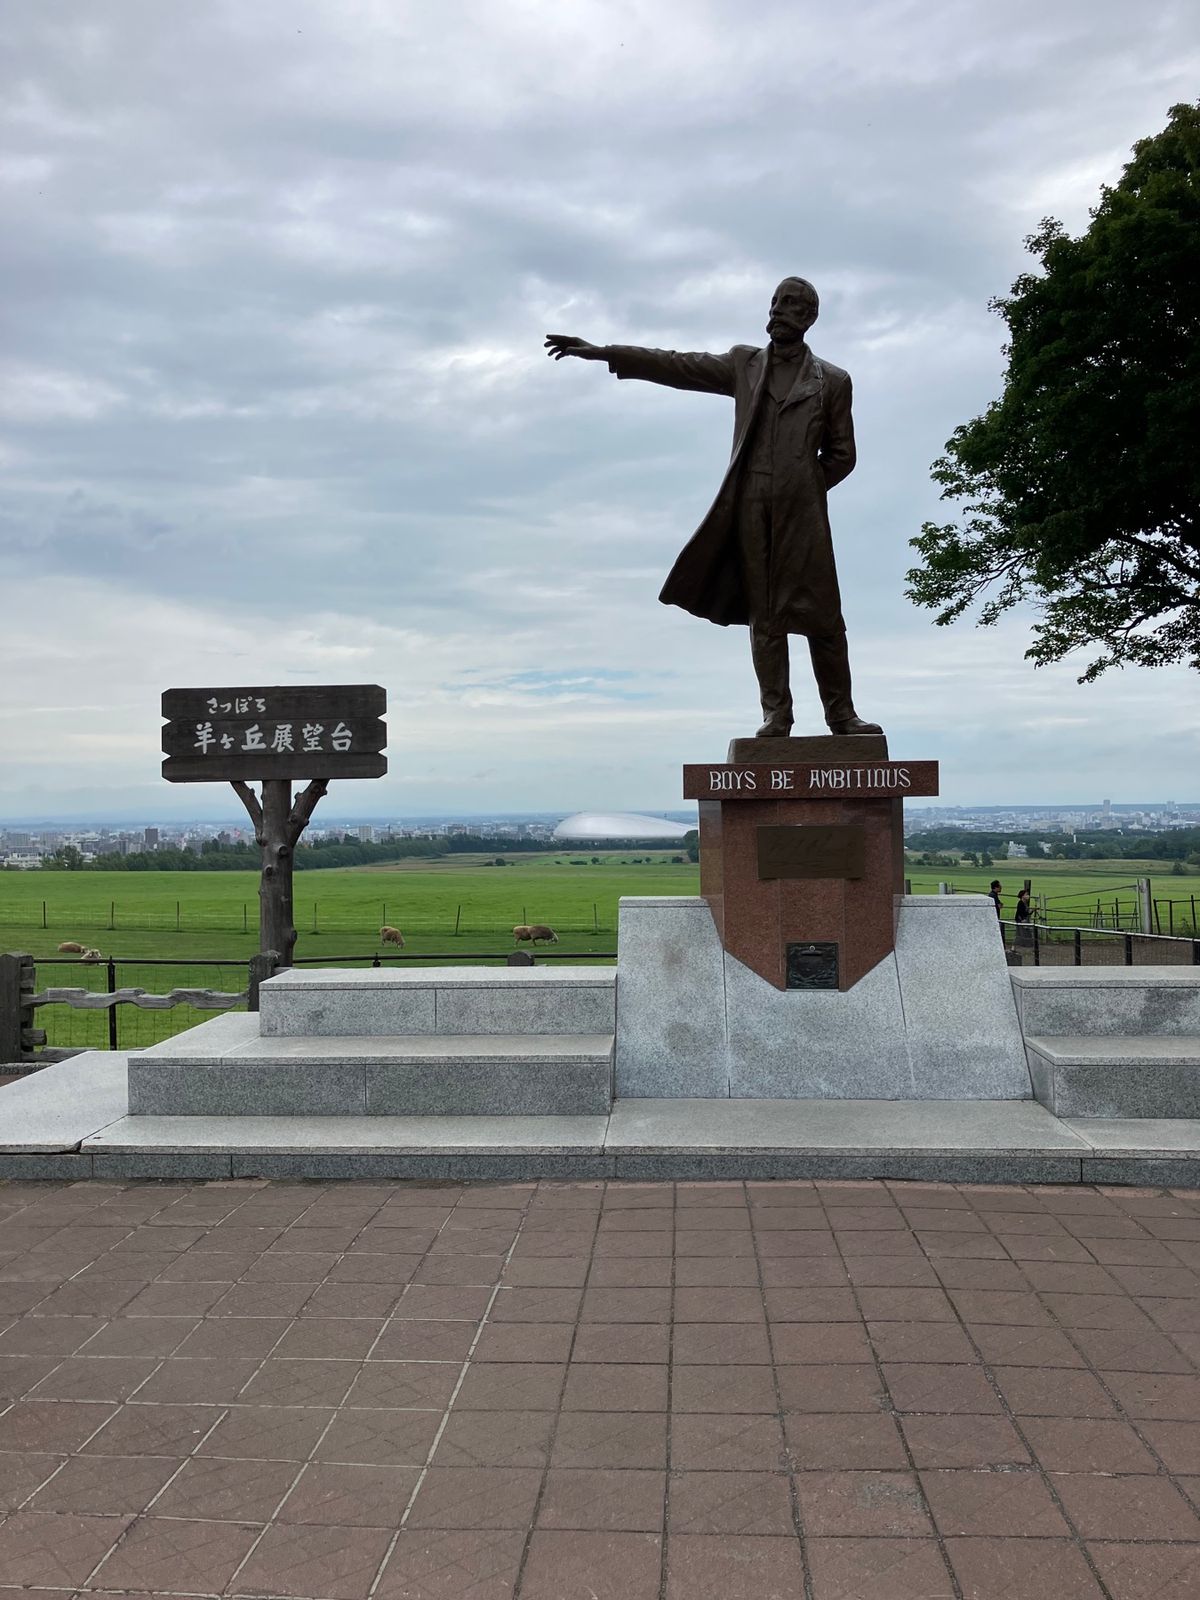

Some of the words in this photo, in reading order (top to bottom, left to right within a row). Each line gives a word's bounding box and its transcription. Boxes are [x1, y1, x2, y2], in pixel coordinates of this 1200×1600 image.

[193, 721, 353, 754] 羊ヶ丘展望台
[709, 770, 757, 791] BOYS
[770, 770, 794, 790] BE
[809, 768, 911, 789] AMBITIOUS
